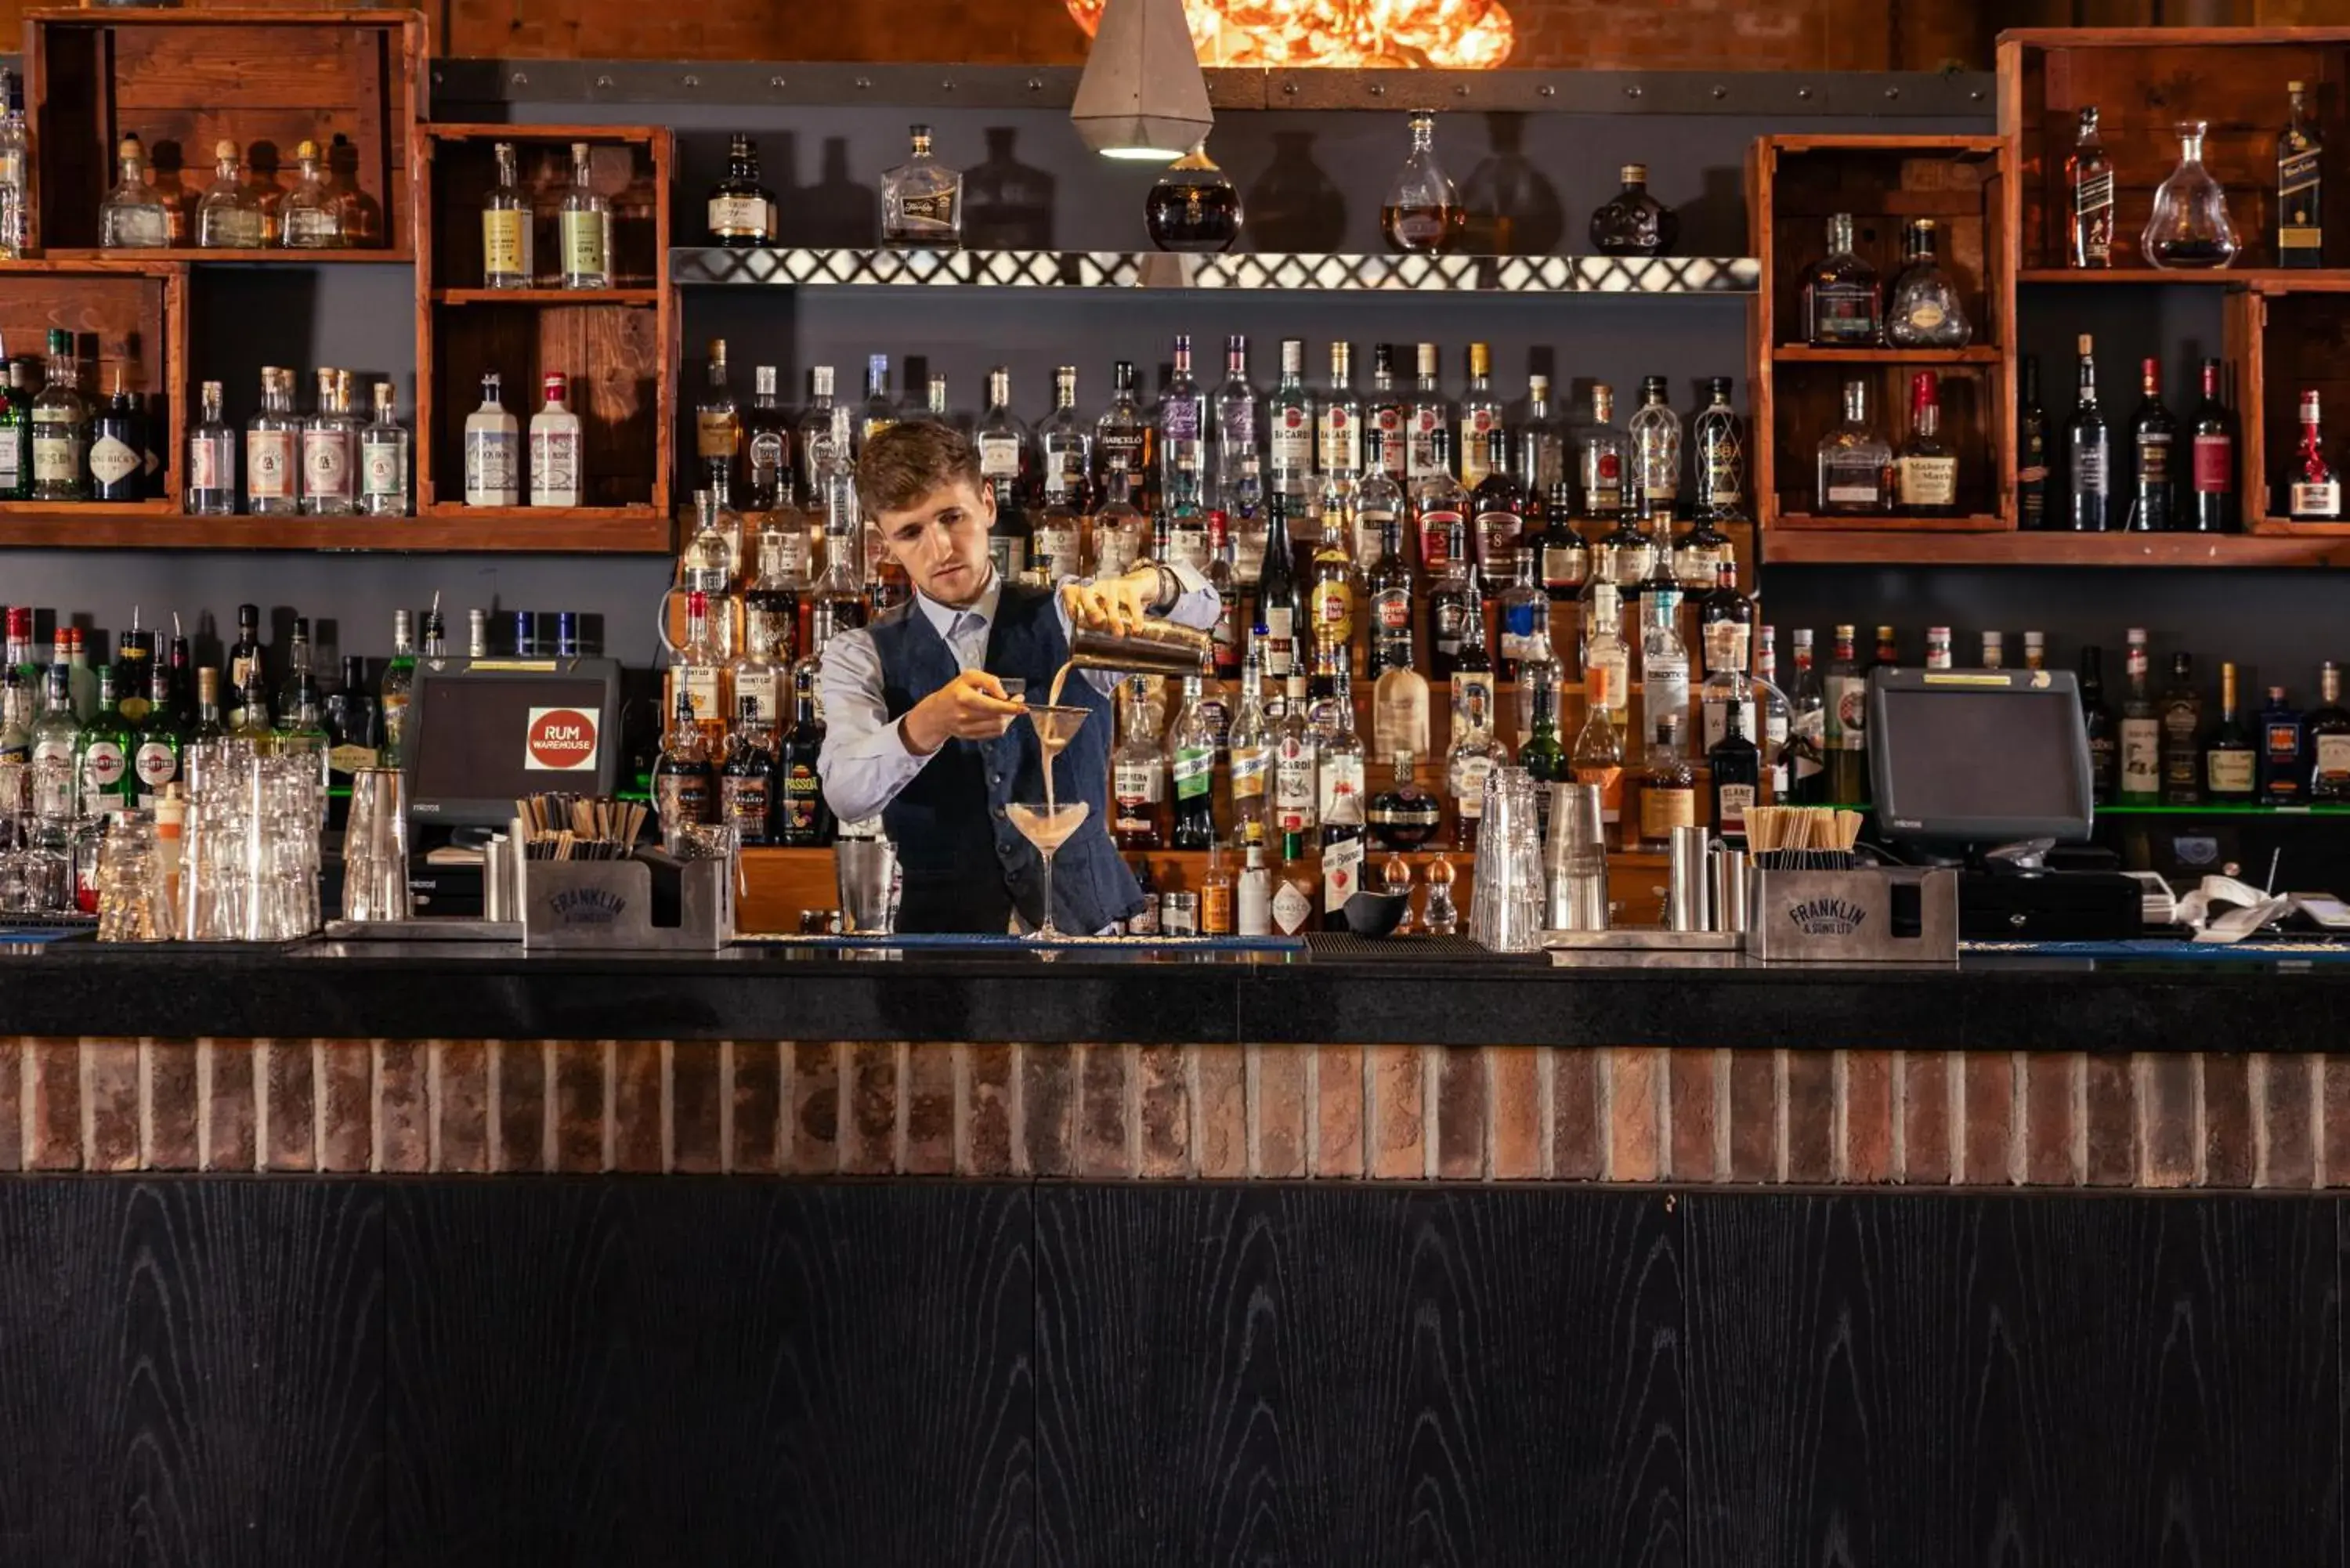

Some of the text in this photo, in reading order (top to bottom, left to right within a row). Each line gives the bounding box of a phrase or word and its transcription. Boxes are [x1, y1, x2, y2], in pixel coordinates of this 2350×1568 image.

[544, 725, 580, 740] RUM
[533, 740, 591, 750] WAREHOUSE
[550, 887, 626, 915] FRANKLIN
[1789, 898, 1867, 926] FRANKLIN
